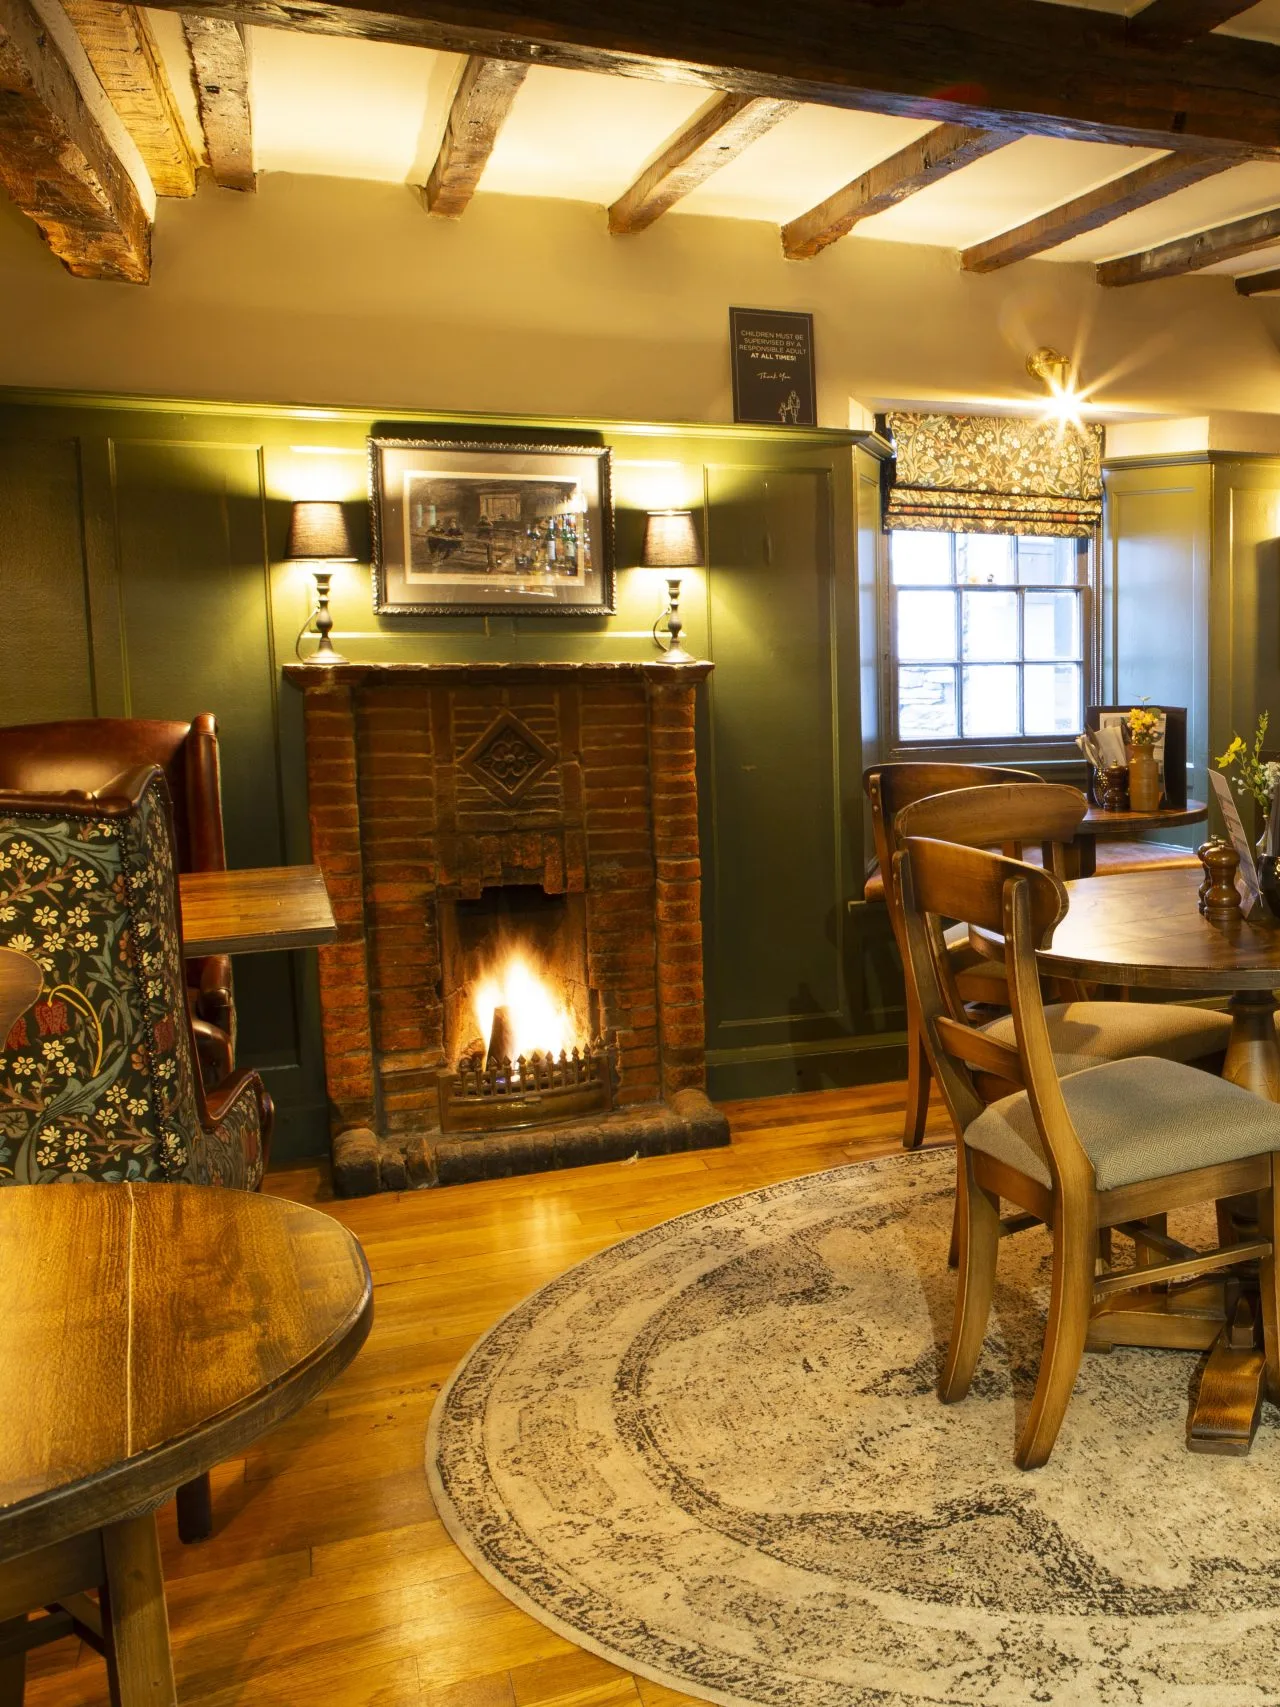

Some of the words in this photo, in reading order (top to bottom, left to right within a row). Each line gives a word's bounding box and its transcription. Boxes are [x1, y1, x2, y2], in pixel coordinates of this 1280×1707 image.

[741, 330, 774, 338] CHILDREN
[776, 332, 793, 340] MUST
[744, 338, 784, 346] SUPERVISED
[739, 345, 784, 353] RESPONSIBLE
[757, 372, 777, 380] Thank
